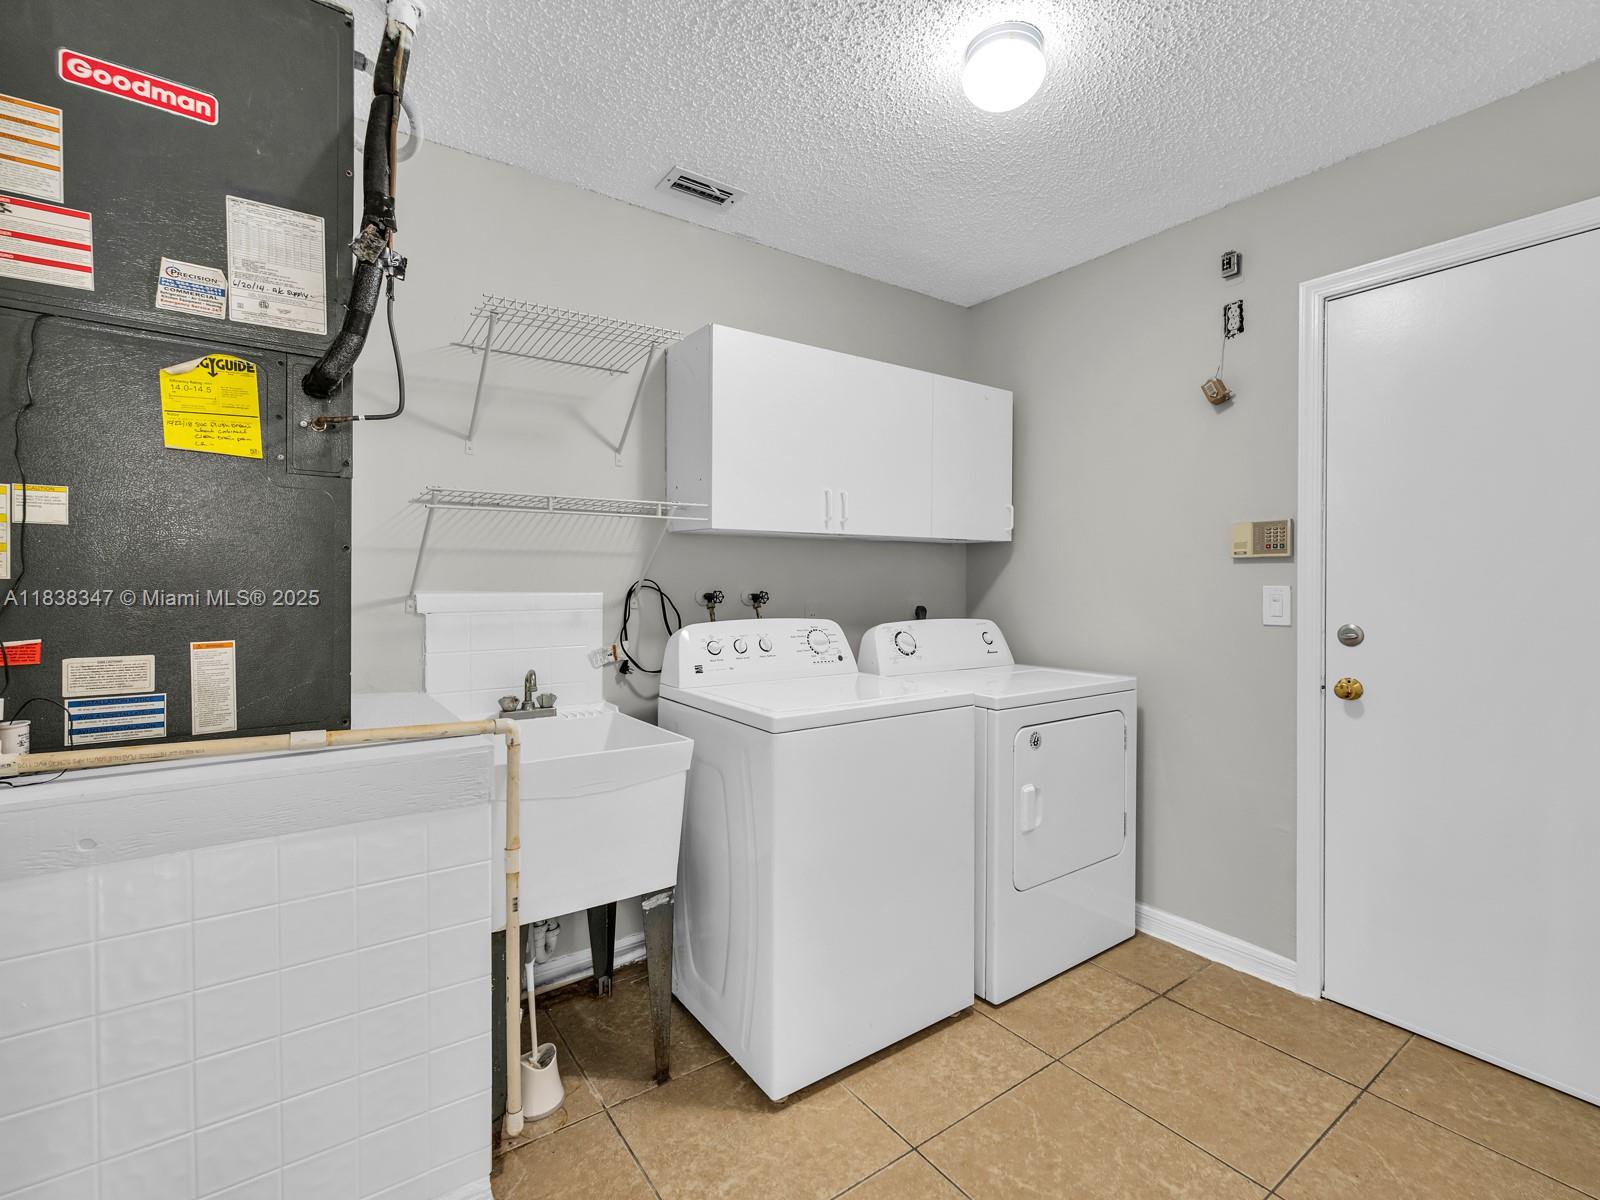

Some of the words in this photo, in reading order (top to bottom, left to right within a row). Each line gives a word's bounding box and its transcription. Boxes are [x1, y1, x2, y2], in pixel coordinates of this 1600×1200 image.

[66, 57, 212, 117] Goodman
[170, 268, 218, 284] PRECISION
[163, 286, 218, 300] COMMERCIAL
[197, 357, 255, 375] GYGUIDE
